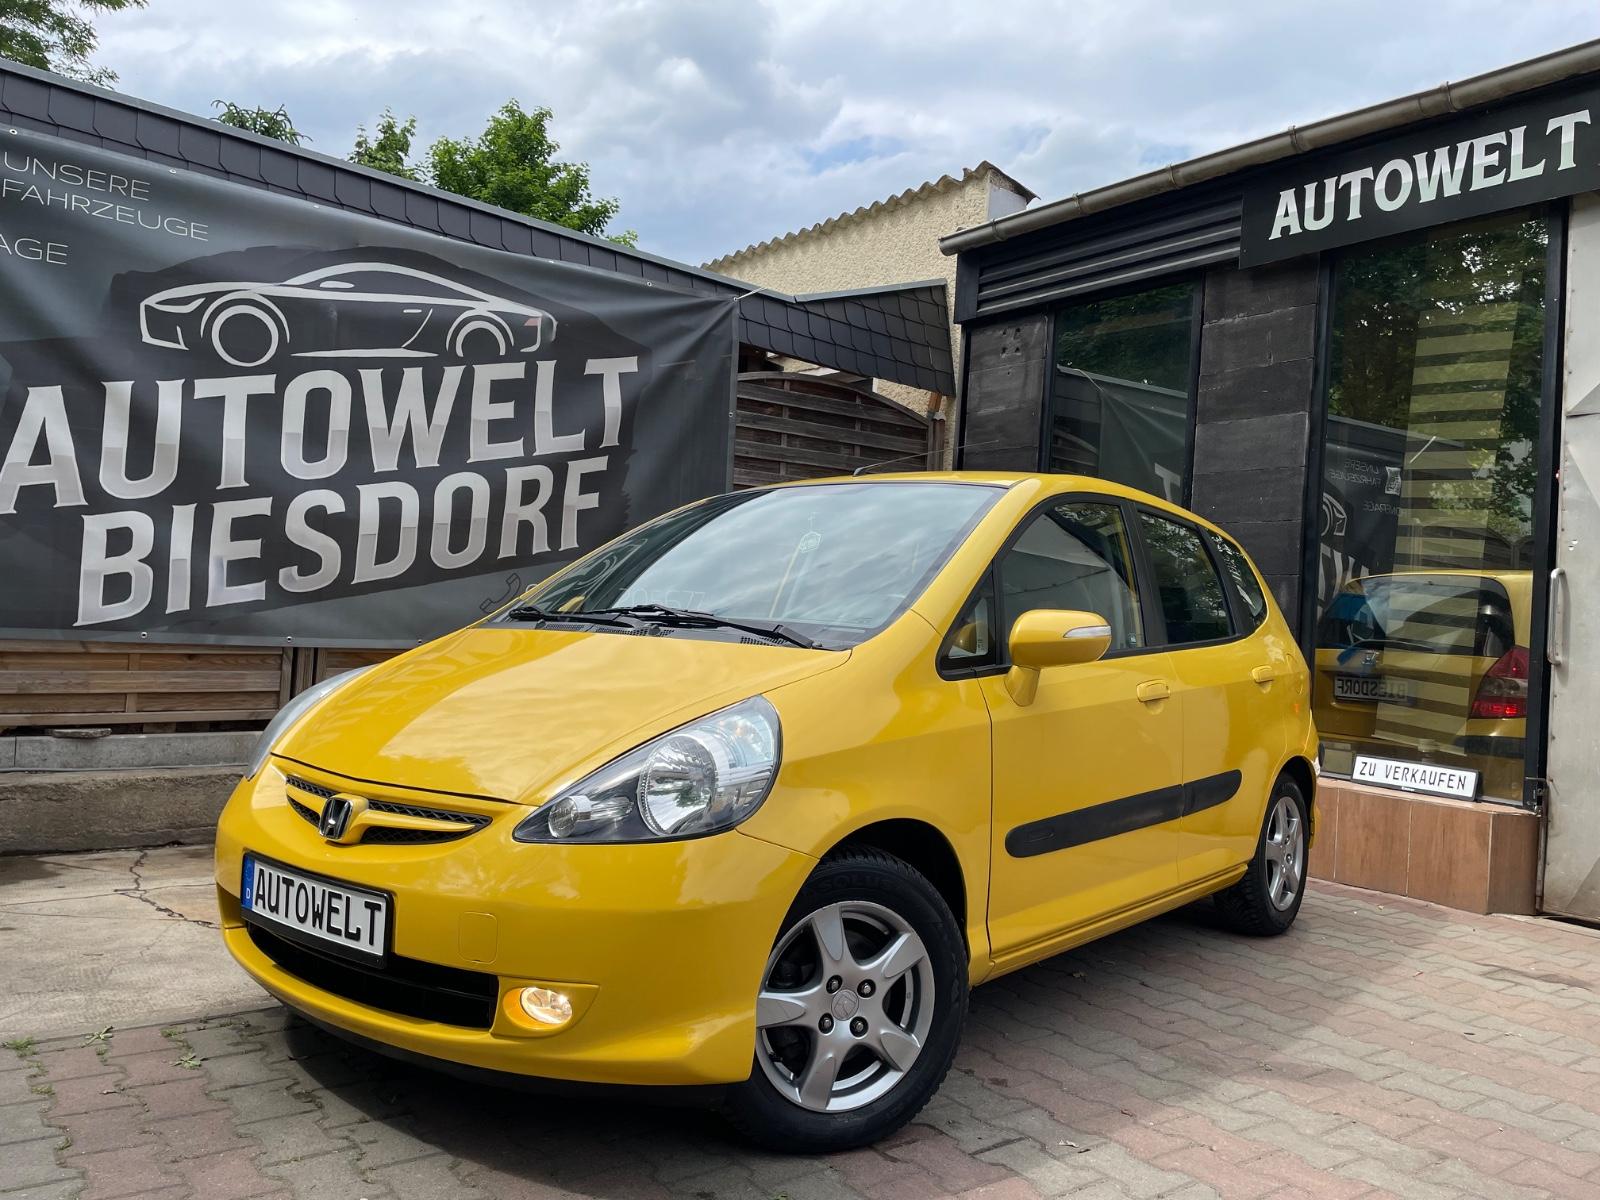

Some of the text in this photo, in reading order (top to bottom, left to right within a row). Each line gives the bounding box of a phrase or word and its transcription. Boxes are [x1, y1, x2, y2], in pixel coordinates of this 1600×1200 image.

[2, 178, 209, 242] FAHRZEUGE
[4, 151, 151, 201] UNSERE
[1268, 109, 1591, 240] AUTOWELT
[0, 355, 639, 514] AUTOWELT
[73, 456, 609, 627] BIESDORF
[1359, 761, 1467, 791] ZU VERKAUFEN
[246, 887, 251, 899] D
[254, 867, 382, 946] AUTOWELT
